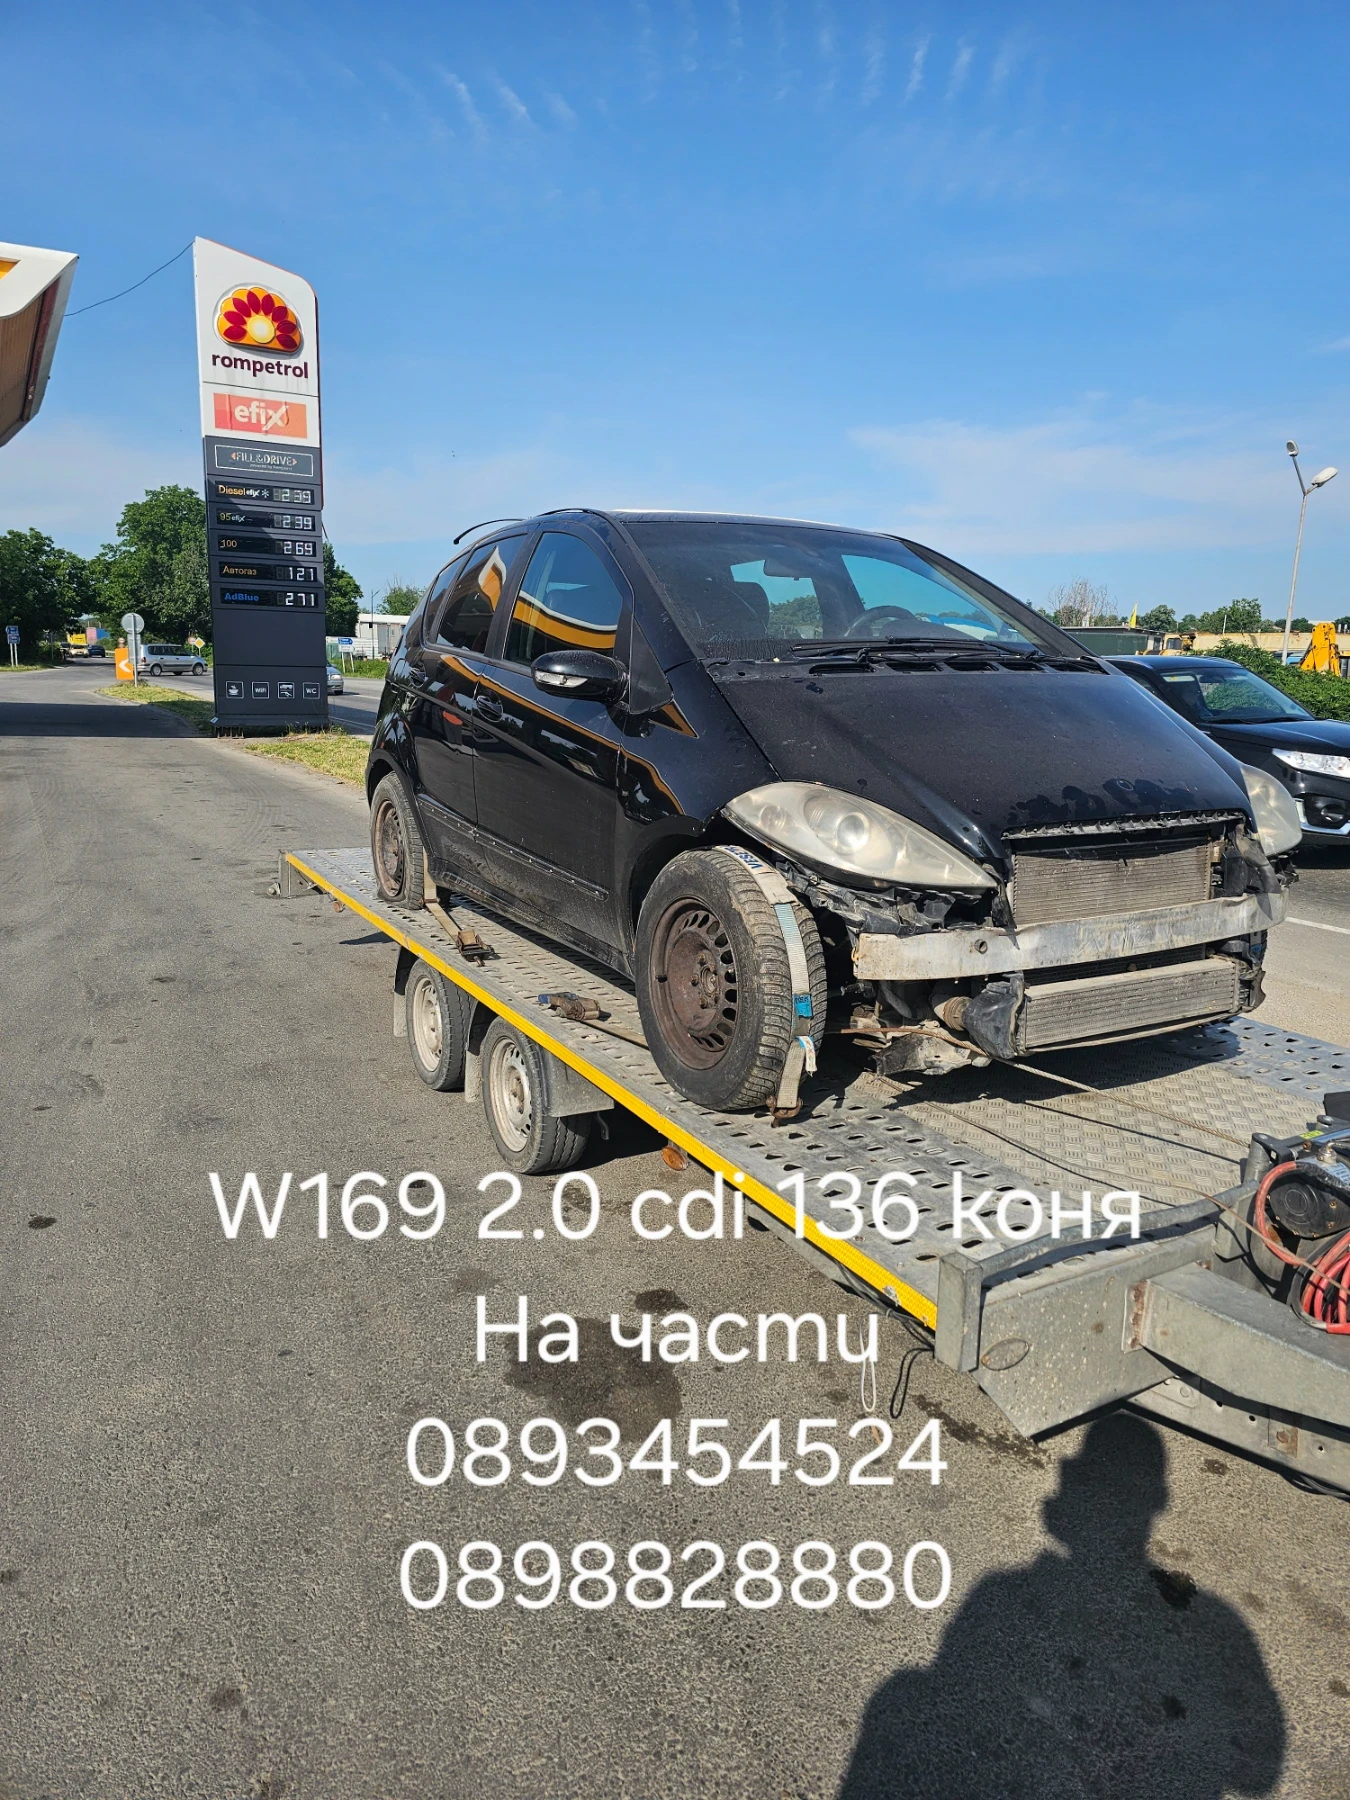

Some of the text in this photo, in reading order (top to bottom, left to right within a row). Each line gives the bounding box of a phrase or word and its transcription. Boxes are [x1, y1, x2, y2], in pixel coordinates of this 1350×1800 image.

[212, 354, 308, 378] rompetrol
[234, 401, 289, 431] efix
[218, 484, 246, 496] Diesel
[220, 513, 231, 521] 95
[220, 539, 238, 548] 100
[222, 566, 257, 575] Автогаз
[224, 592, 260, 602] AdBlue
